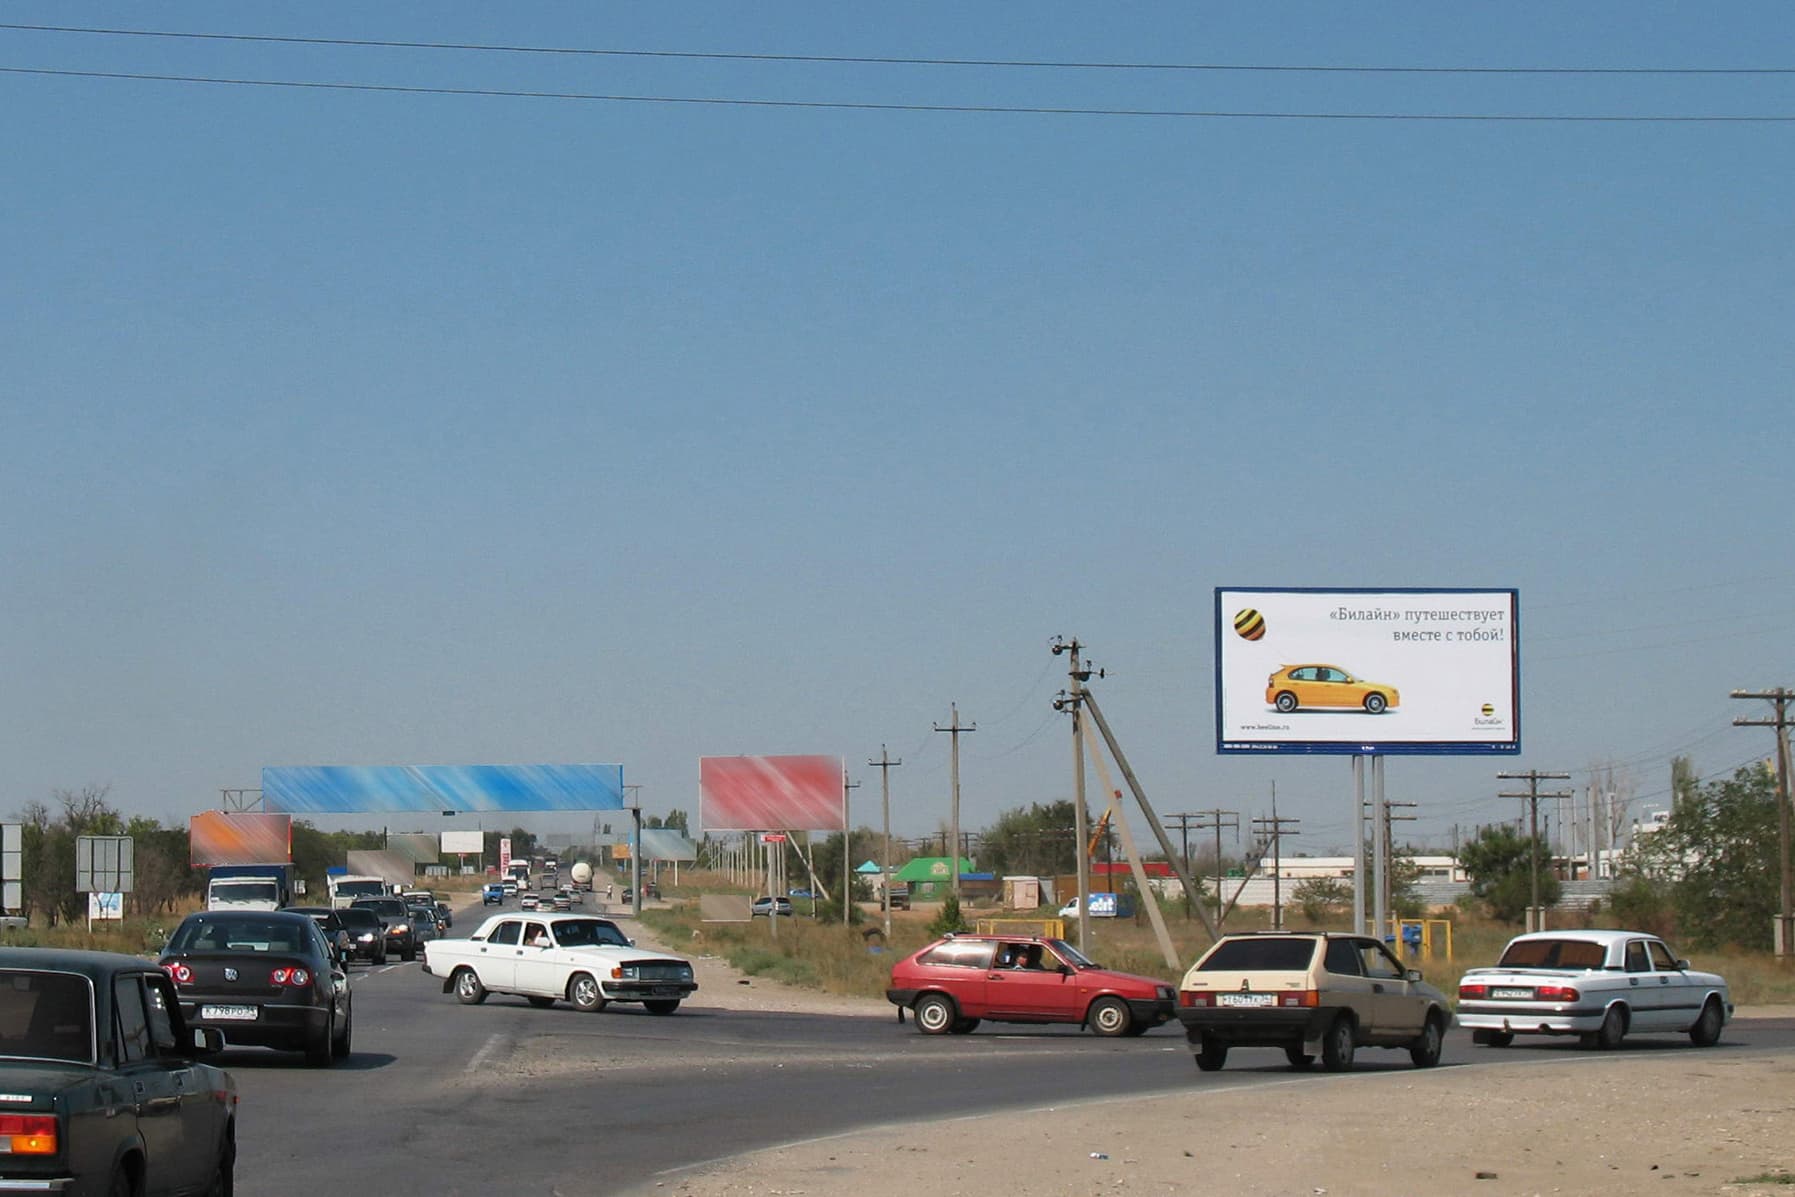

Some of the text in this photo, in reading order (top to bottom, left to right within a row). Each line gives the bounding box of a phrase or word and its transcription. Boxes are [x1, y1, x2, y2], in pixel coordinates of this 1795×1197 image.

[1329, 607, 1505, 624] «Билайн» путешествует
[1393, 627, 1505, 642] вместе с тобой!
